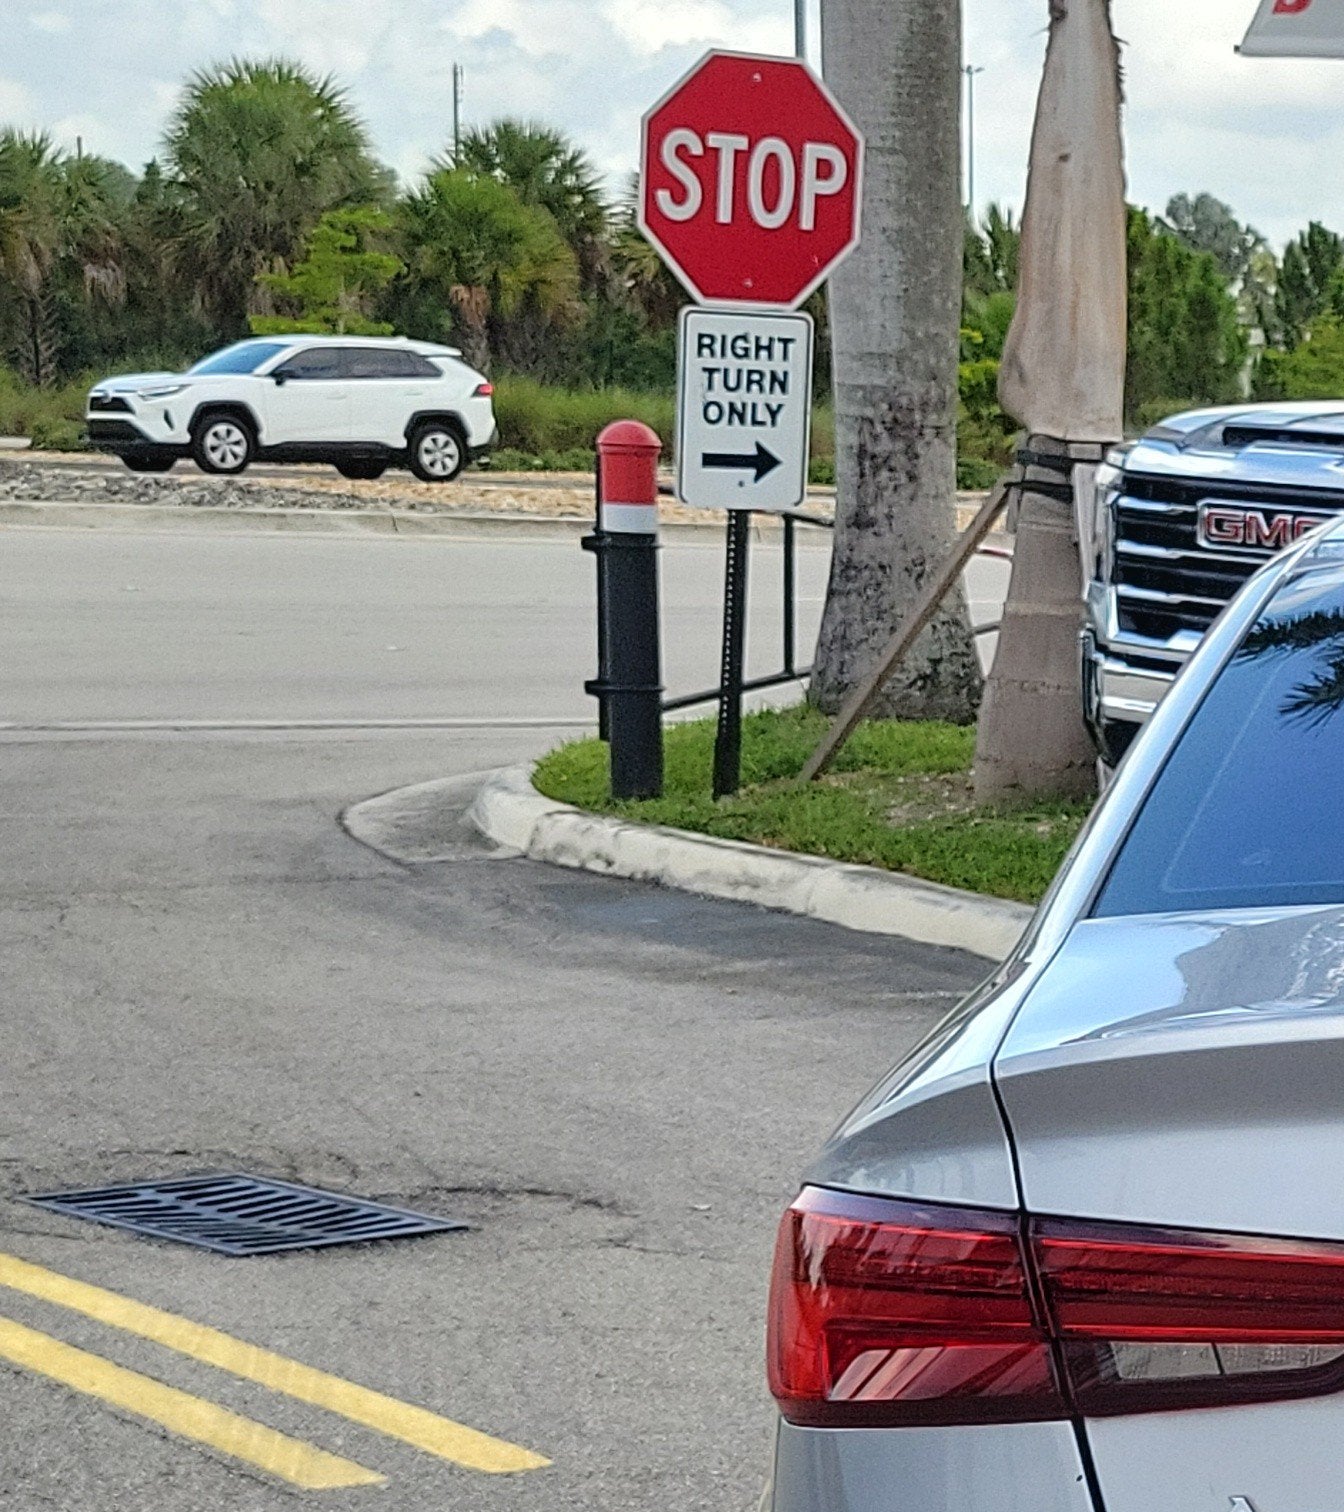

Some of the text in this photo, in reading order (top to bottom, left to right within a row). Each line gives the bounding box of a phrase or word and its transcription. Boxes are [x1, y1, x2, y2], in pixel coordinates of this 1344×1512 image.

[654, 127, 848, 231] STOP
[697, 333, 796, 362] RIGHT
[701, 366, 790, 395] TURN
[703, 400, 784, 428] ONLY
